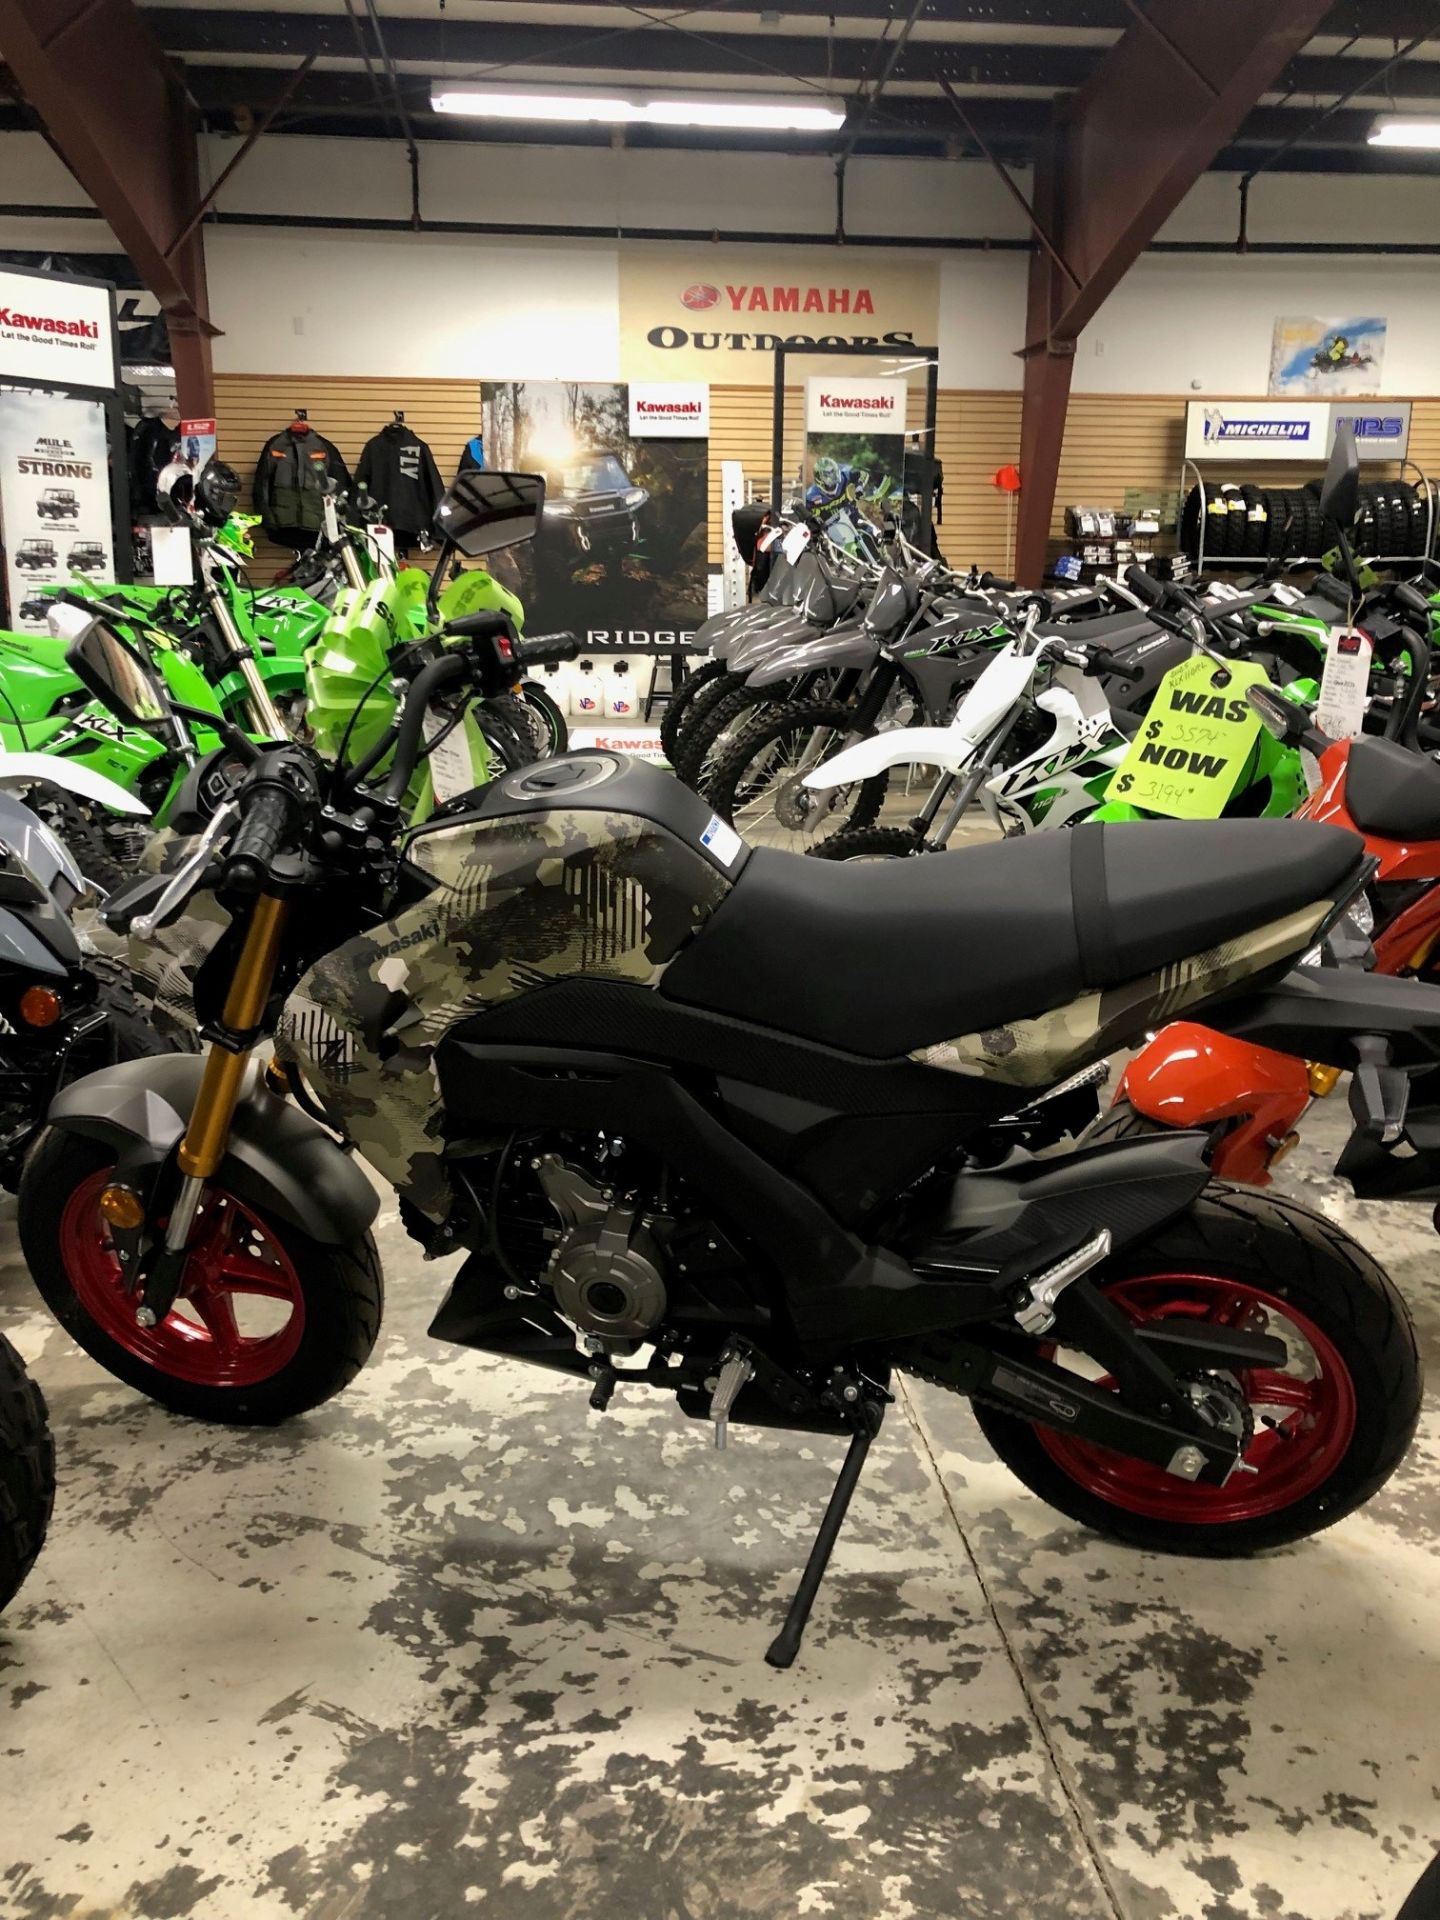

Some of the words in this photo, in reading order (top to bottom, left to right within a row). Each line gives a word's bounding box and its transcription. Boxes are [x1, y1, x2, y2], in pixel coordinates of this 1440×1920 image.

[726, 286, 874, 315] YAMAHA
[0, 307, 98, 338] Kawasaki
[2, 331, 14, 339] Let
[17, 333, 30, 341] the
[32, 335, 53, 345] Good
[55, 338, 78, 348] Times
[637, 401, 702, 412] Kawasaki
[820, 394, 894, 409] Kawasaki
[1225, 423, 1306, 436] MICHELIN
[17, 460, 93, 479] STRONG
[400, 446, 421, 480] FLY
[587, 630, 697, 645] RIDGE
[926, 621, 1004, 656] KLX
[1169, 689, 1250, 723] WAS
[79, 713, 138, 743] KLX
[1145, 720, 1164, 740] $
[595, 737, 663, 751] Kawas
[1001, 722, 1110, 797] KLX
[1138, 742, 1230, 779] NOW
[1116, 773, 1135, 793] $
